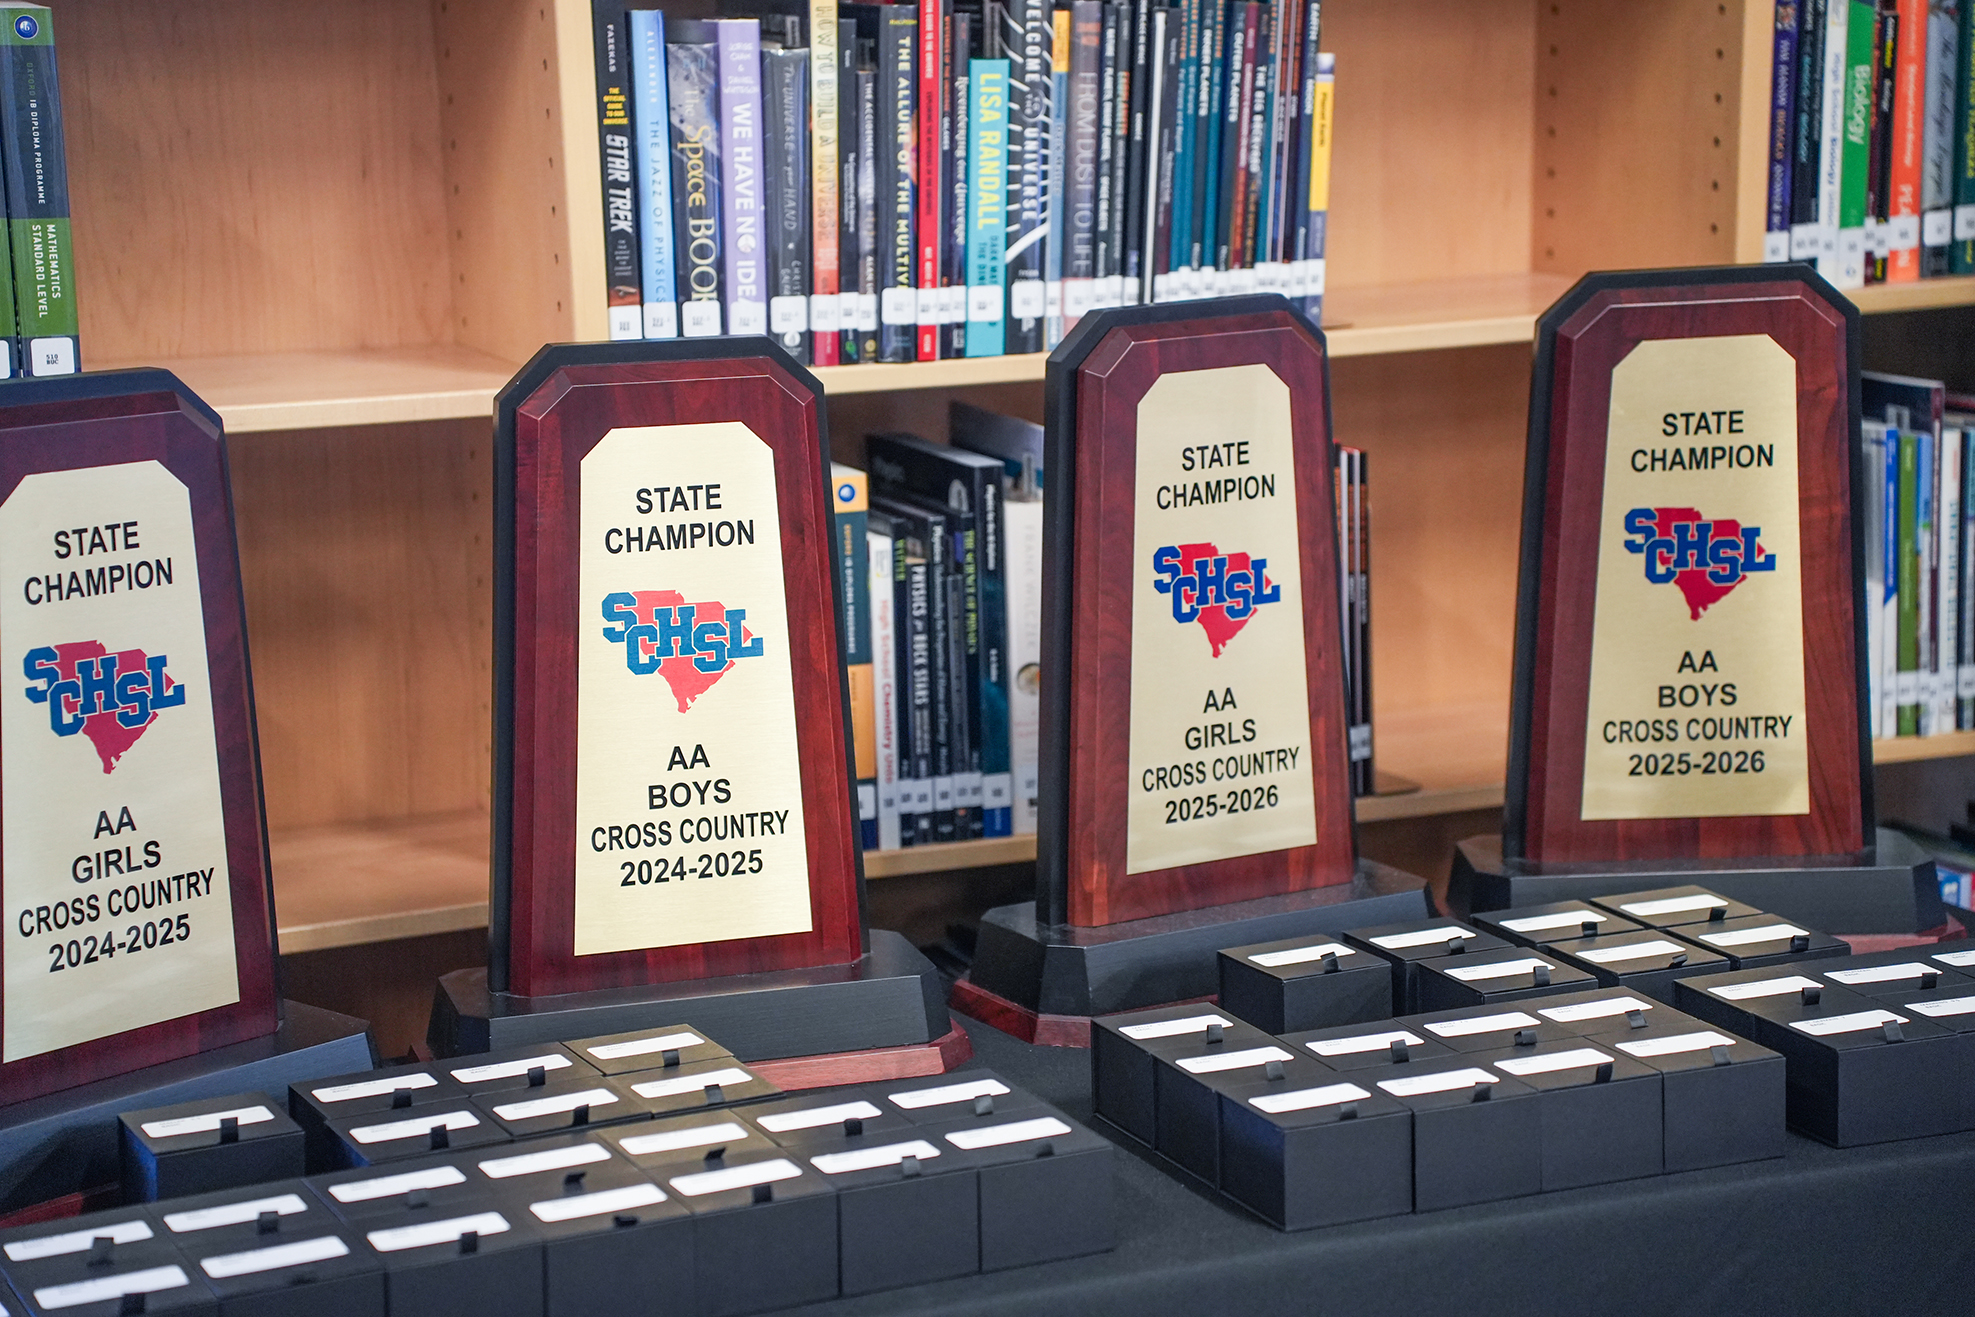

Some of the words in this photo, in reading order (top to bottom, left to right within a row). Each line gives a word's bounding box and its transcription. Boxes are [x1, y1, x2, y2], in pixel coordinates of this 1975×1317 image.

[606, 24, 617, 73] FAZEKAS
[815, 6, 835, 48] HOW
[898, 36, 911, 71] THE
[29, 99, 37, 109] IB
[897, 77, 910, 142] ALLURE
[980, 73, 1002, 124] LISA
[1076, 72, 1098, 132] FROM
[1198, 66, 1211, 117] PLANETS
[1228, 71, 1242, 122] PLANETS
[1847, 64, 1872, 145] Biology
[30, 111, 41, 150] DIPLOMA
[650, 120, 661, 149] THE
[731, 103, 752, 140] WE
[783, 87, 797, 150] UNIVERSE
[34, 153, 46, 205] PROGRAMME
[605, 133, 629, 183] STAR
[651, 158, 662, 199] JAZZ
[677, 124, 712, 207] Space
[733, 147, 755, 210] HAVE
[896, 151, 910, 174] OF
[977, 130, 1002, 230] RANDALL
[1022, 127, 1040, 220] UNIVERSE
[1074, 138, 1097, 191] DUST
[609, 186, 634, 234] TREK
[653, 208, 664, 228] OF
[783, 188, 797, 232] HAND
[896, 178, 910, 214] THE
[1073, 201, 1095, 228] TO
[1897, 183, 1914, 268] PEAON
[32, 224, 46, 282] STANDARD
[47, 224, 61, 299] MATHEMATICS
[653, 240, 667, 304] PHYSICS
[895, 219, 910, 288] MULTIV
[1072, 233, 1093, 272] LIFE
[37, 284, 49, 319] LEVEL
[736, 260, 758, 302] IDE
[1662, 410, 1744, 437] STATE
[1181, 441, 1250, 472] STATE
[1630, 443, 1774, 473] CHAMPION
[636, 483, 722, 515] STATE
[1156, 473, 1275, 510] CHAMPION
[54, 520, 140, 560] STATE
[605, 519, 755, 555] CHAMPION
[1623, 507, 1777, 584] SCHSL
[24, 557, 173, 606] CHAMPION
[1153, 545, 1281, 624] SCHSL
[601, 591, 764, 676] SCHSL
[1677, 650, 1719, 674] AA
[23, 645, 186, 738] SCHSL
[1203, 687, 1237, 714] AA
[1658, 683, 1737, 708] BOYS
[882, 683, 894, 750] Chemistry
[1184, 718, 1256, 751] GIRLS
[1603, 718, 1679, 744] CROSS
[1686, 715, 1793, 742] COUNTRY
[667, 743, 711, 772] AA
[1142, 760, 1207, 792] CROSS
[1212, 746, 1300, 782] COUNTRY
[1628, 750, 1765, 777] 2025-2026
[648, 778, 732, 810] BOYS
[1164, 784, 1279, 825] 2025-2026
[93, 805, 137, 840] AA
[591, 820, 672, 853] CROSS
[679, 809, 789, 844] COUNTRY
[71, 840, 162, 884] GIRLS
[620, 849, 763, 887] 2024-2025
[18, 893, 101, 938] CROSS
[107, 867, 215, 917] COUNTRY
[49, 913, 191, 973] 2024-2025
